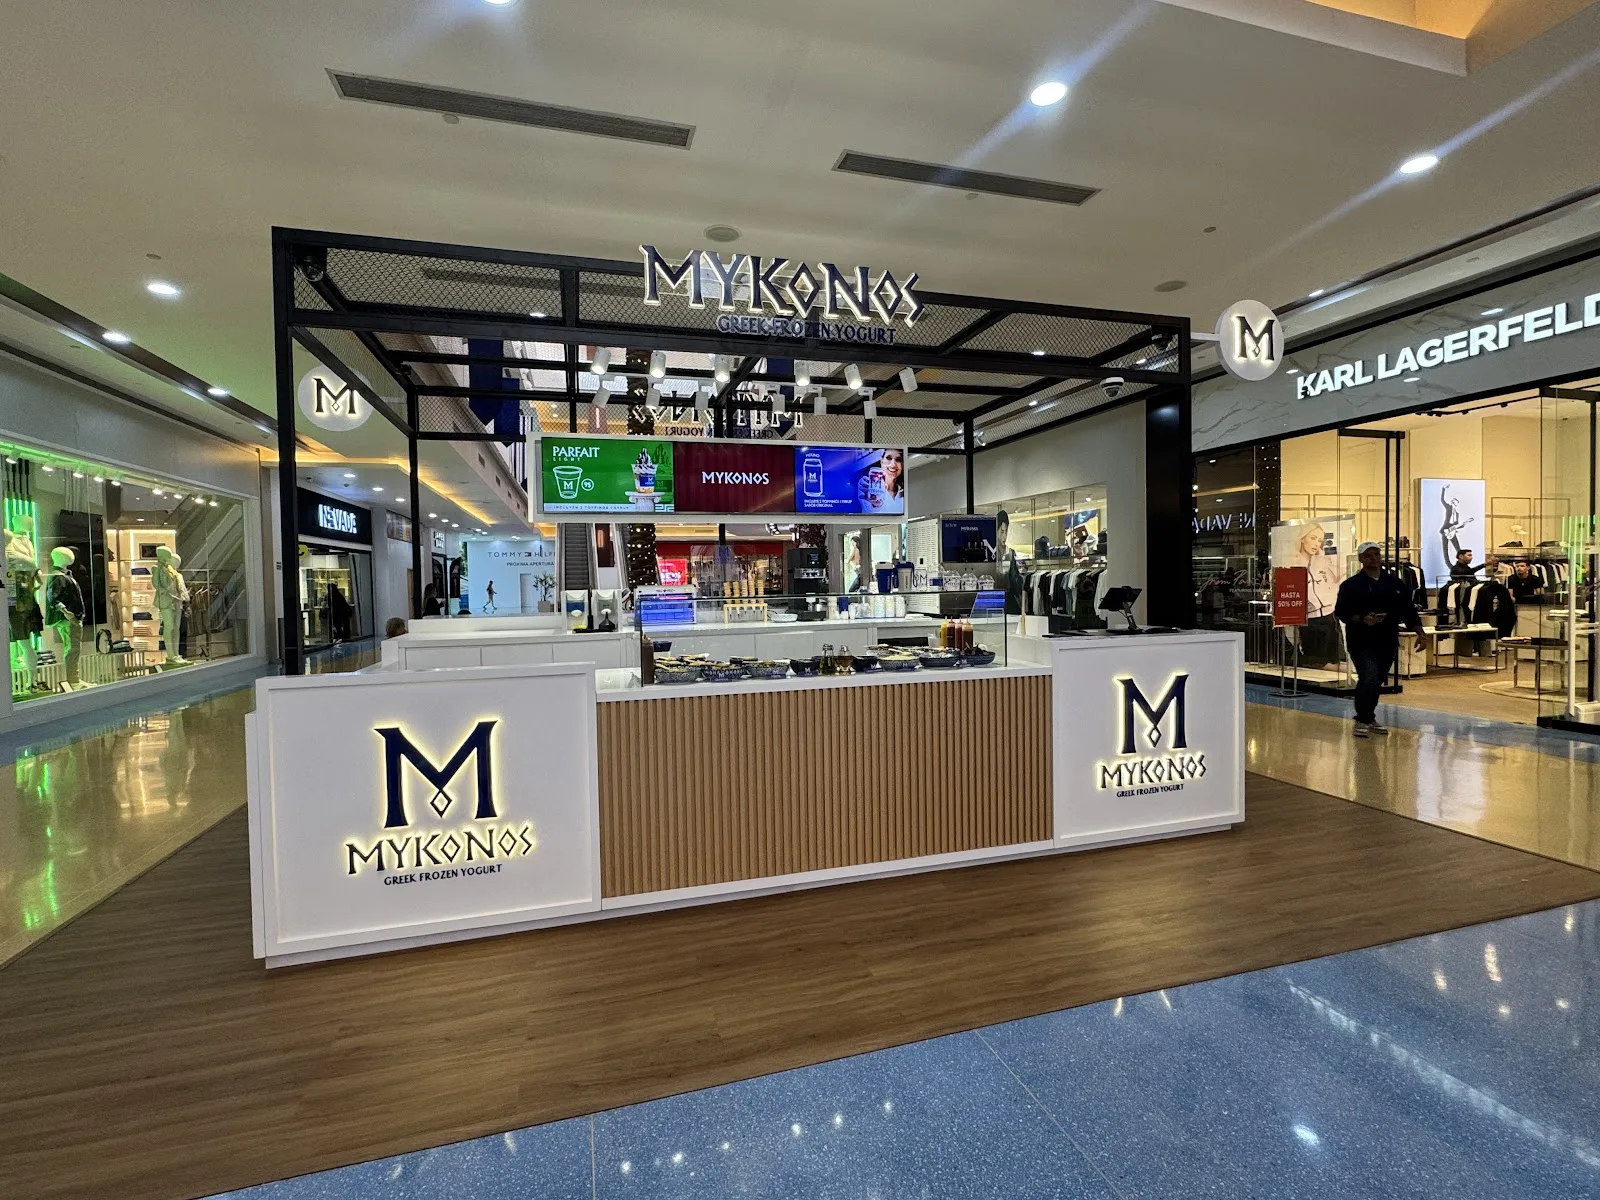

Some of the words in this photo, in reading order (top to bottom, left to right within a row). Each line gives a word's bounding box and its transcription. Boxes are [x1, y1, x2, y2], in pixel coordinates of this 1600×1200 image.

[639, 245, 925, 327] MYKONOS
[717, 314, 768, 334] GREEK
[771, 317, 831, 340] FROZEN
[835, 325, 896, 345] YOGURT
[1236, 315, 1276, 361] M
[312, 377, 357, 415] M
[1297, 362, 1374, 400] KARL
[553, 446, 600, 458] PARFAIT
[702, 471, 770, 485] MYKONOS
[1277, 600, 1290, 608] 50%
[1280, 591, 1301, 599] HASTA
[1116, 673, 1190, 755] M
[372, 719, 499, 829] M
[1100, 754, 1207, 789] MYKONOS
[1116, 787, 1136, 798] GREEK
[1136, 785, 1160, 796] FROZEN
[1160, 783, 1185, 793] YOGURT
[345, 825, 533, 875] MYKONOS
[383, 871, 417, 886] GREEK
[419, 867, 459, 882] FROZEN
[460, 863, 503, 879] YOGURT
